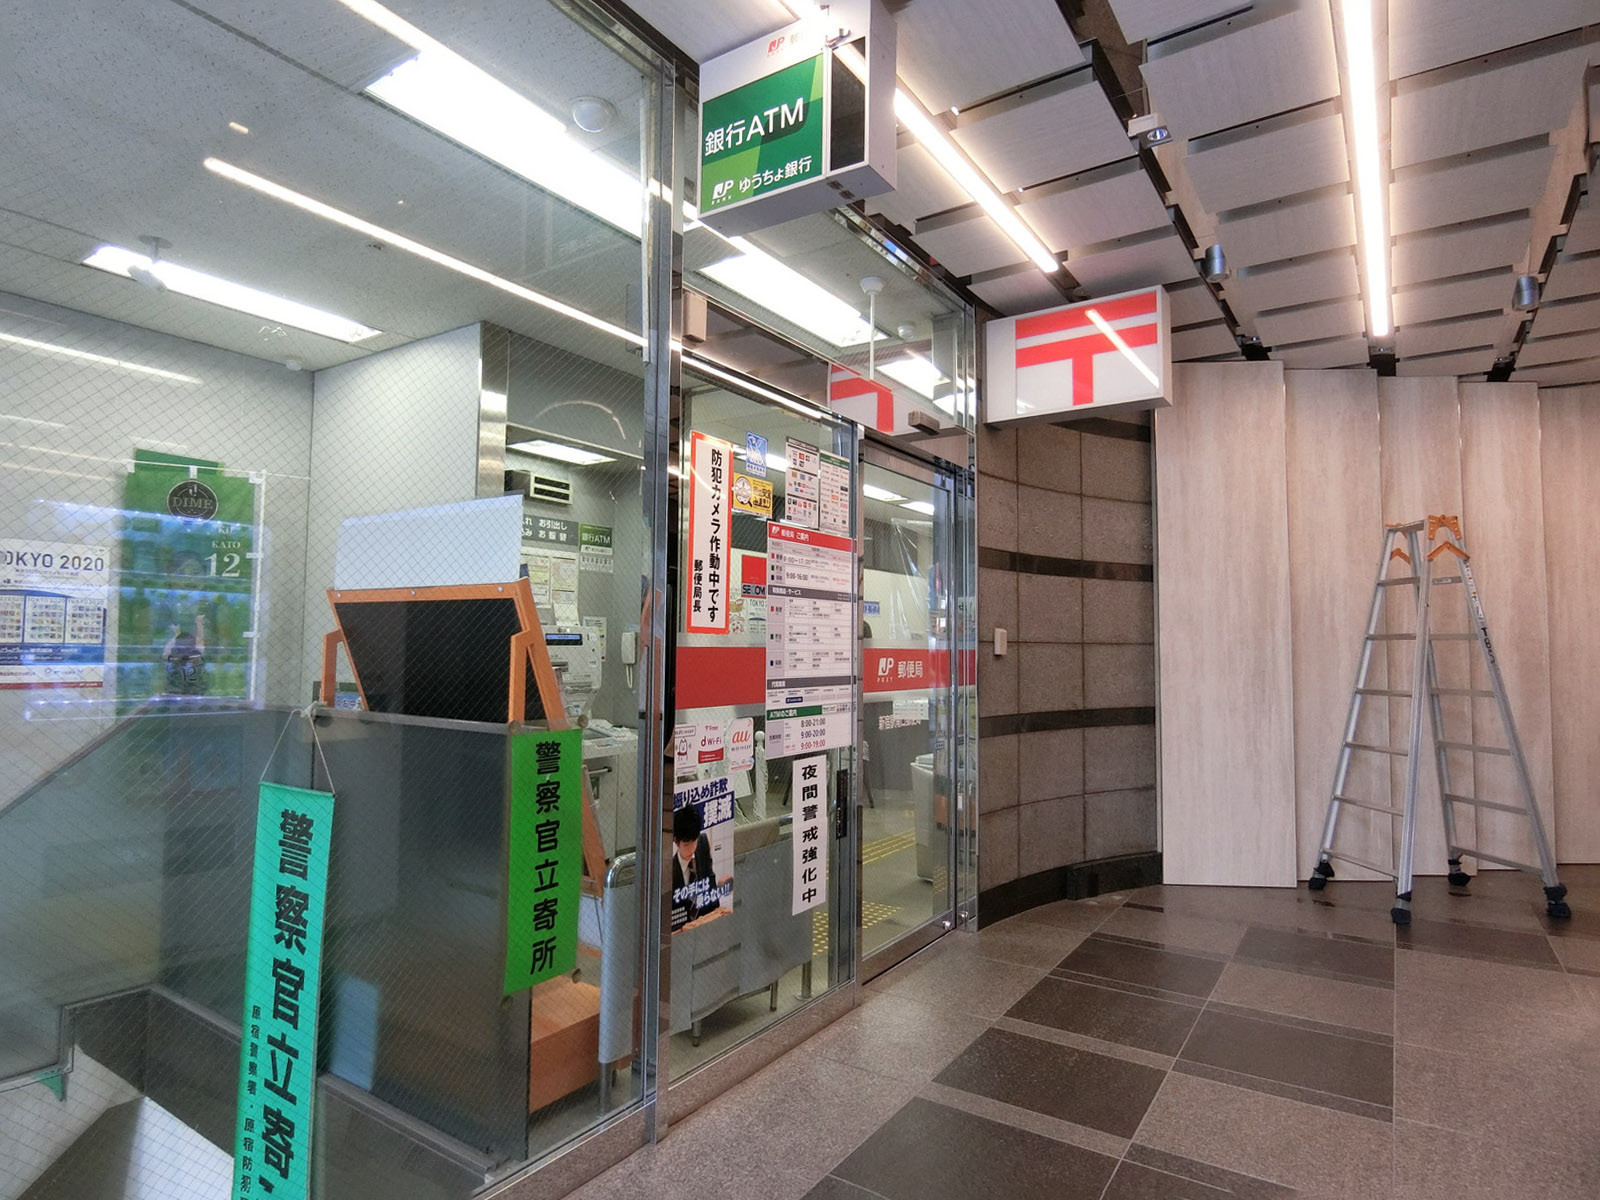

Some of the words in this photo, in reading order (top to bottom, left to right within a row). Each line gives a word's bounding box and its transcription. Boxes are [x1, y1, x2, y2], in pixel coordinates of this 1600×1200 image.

[704, 97, 804, 157] 銀行ATM
[739, 155, 813, 193] ゆうちょ銀行
[172, 497, 213, 511] DIME
[212, 541, 241, 549] KATO
[708, 448, 723, 623] 防犯カメラ作動中です
[59, 555, 104, 571] 2020
[205, 553, 241, 577] 12
[693, 559, 703, 613] 郵便局長
[742, 584, 766, 596] SECOM
[898, 661, 923, 678] 郵便局
[707, 736, 722, 745] Wi-Fi
[732, 731, 751, 743] au
[703, 793, 732, 828] 撲滅
[802, 764, 818, 903] 夜間警戒強化中
[530, 740, 562, 975] 警察官立寄所
[673, 877, 710, 903] その手には
[259, 808, 314, 1200] 警察官立寄
